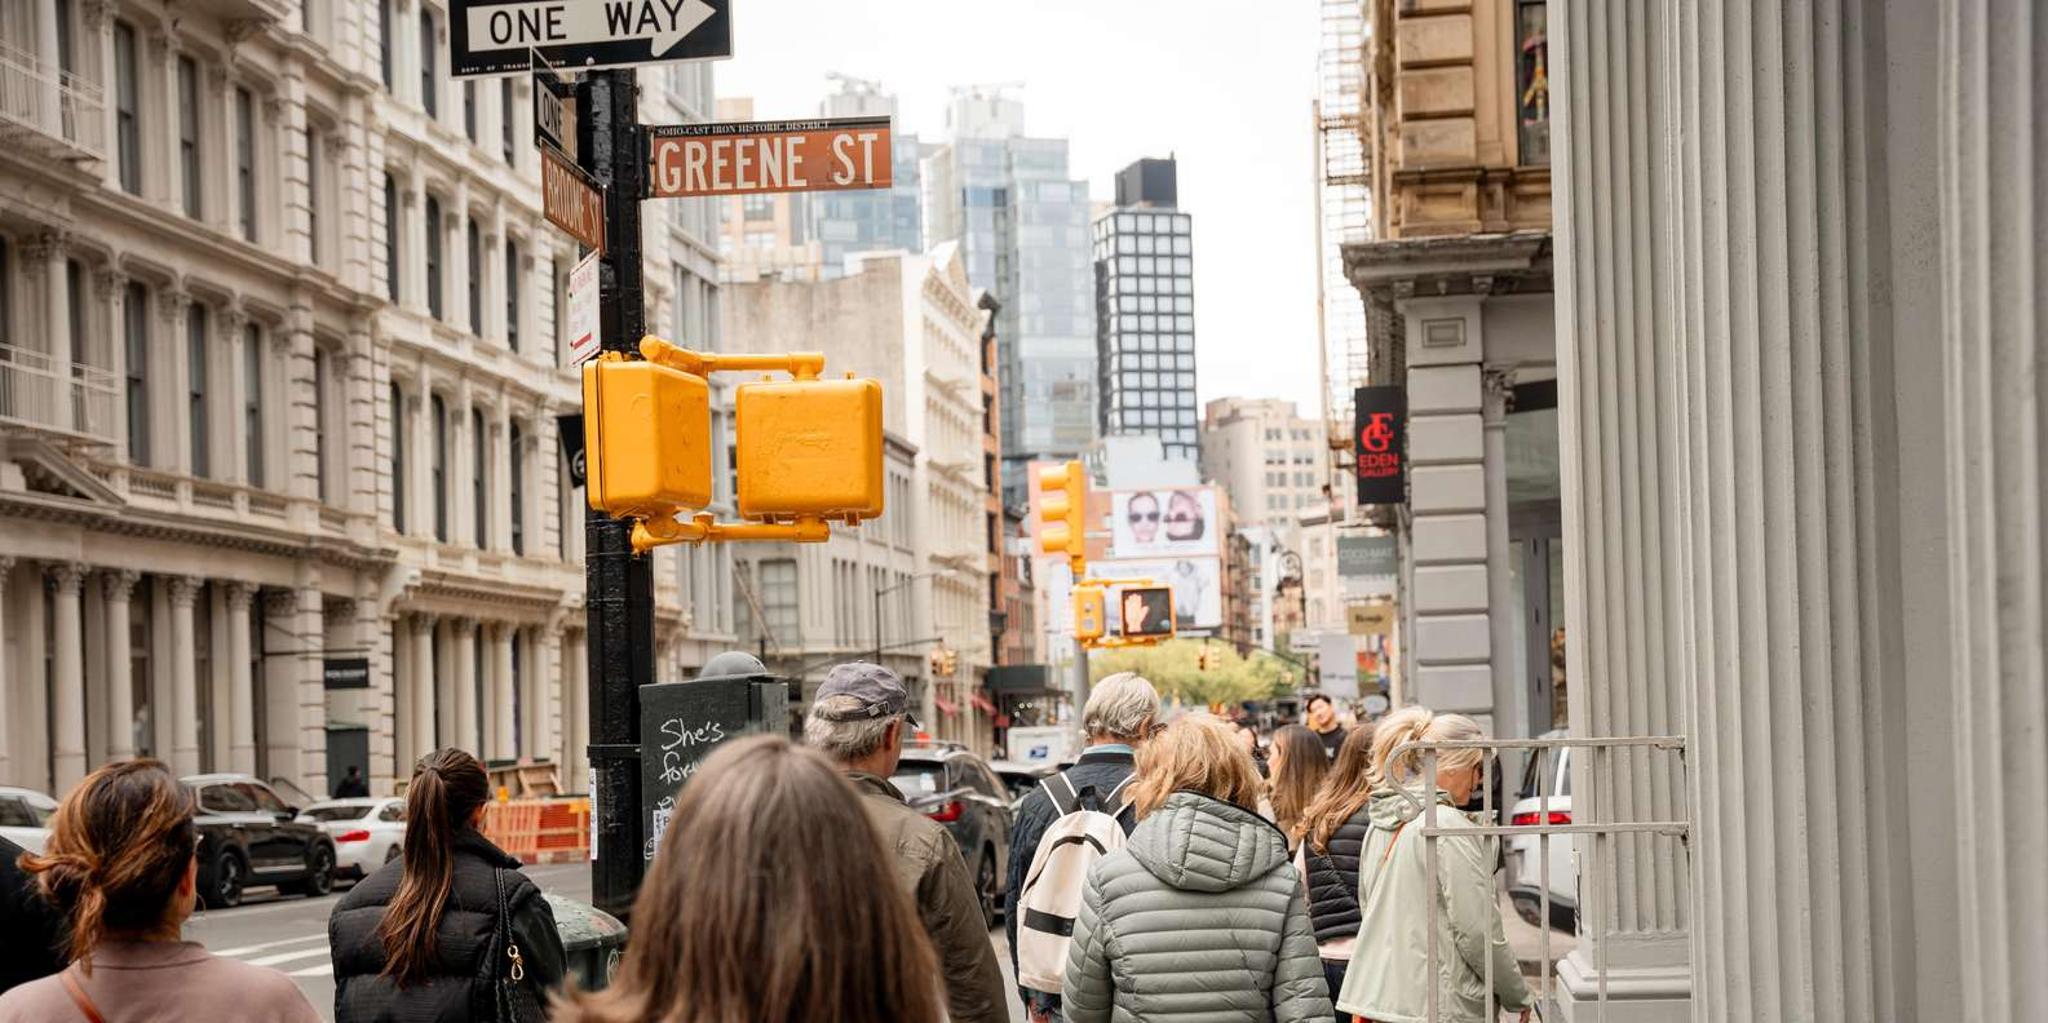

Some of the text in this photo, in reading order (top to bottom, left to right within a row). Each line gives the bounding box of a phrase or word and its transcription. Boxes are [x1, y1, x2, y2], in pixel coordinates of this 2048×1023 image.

[490, 0, 684, 44] ONE WAY
[658, 120, 831, 137] SOHO-CAST IRON HISTORIC DISTRICT
[659, 135, 807, 193] GREENE
[832, 132, 878, 186] ST
[546, 157, 585, 239] BROOME
[1360, 454, 1399, 467] EDEN
[660, 717, 725, 750] She's
